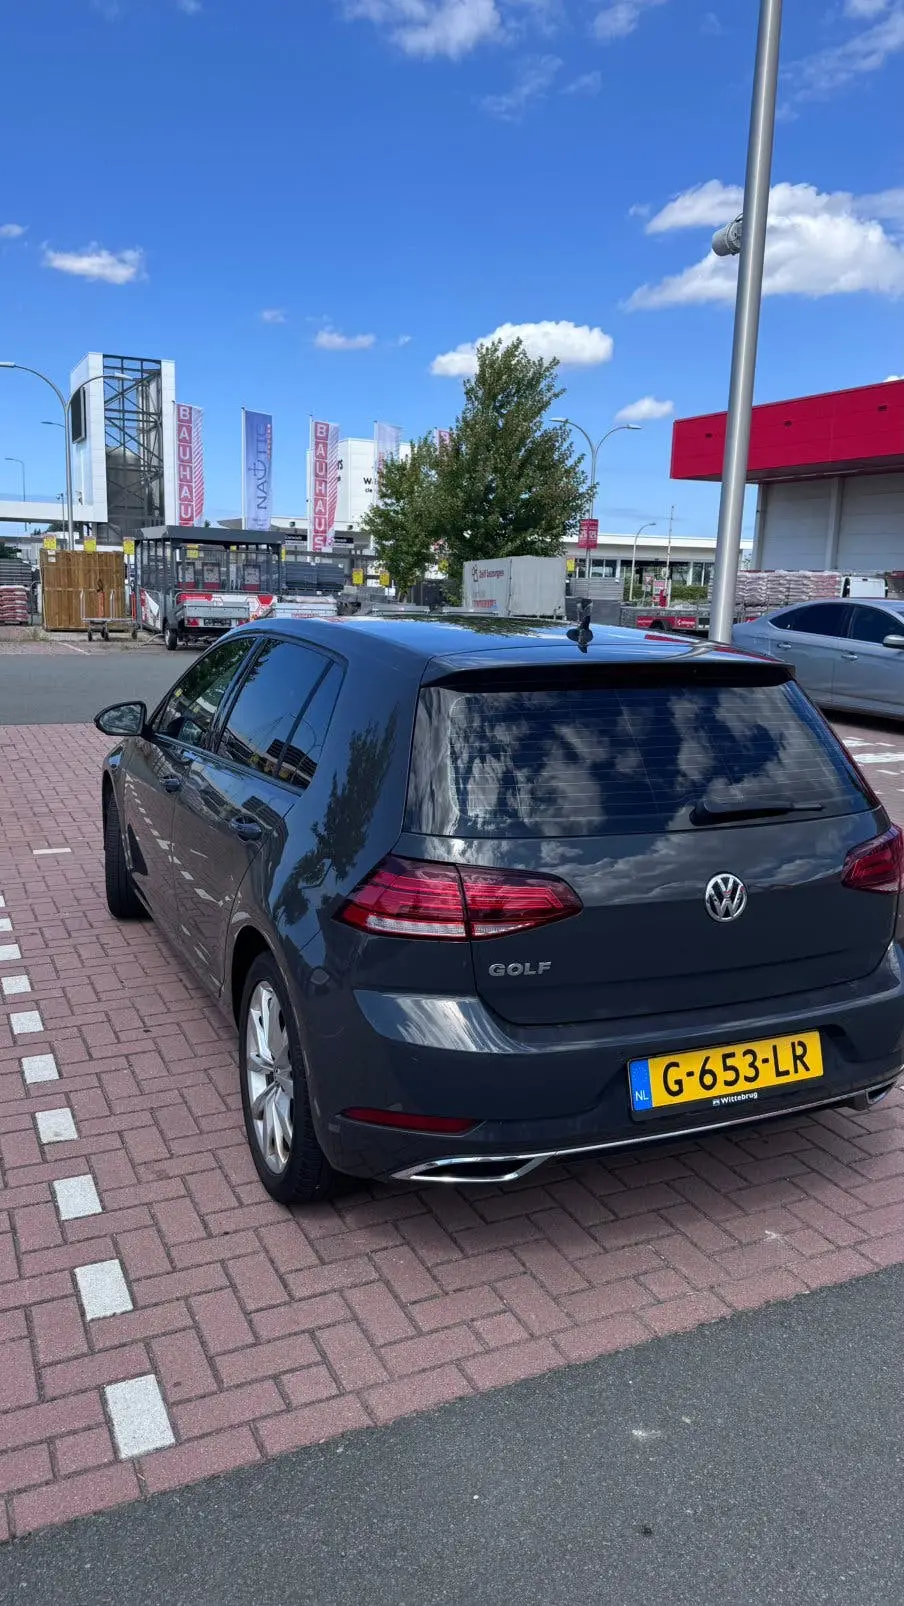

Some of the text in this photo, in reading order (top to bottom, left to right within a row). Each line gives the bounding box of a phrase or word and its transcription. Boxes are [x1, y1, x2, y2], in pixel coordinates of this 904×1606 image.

[179, 405, 193, 525] BAUHAU
[314, 423, 328, 549] BAUHAUS
[488, 961, 552, 977] GOLF
[662, 1040, 811, 1097] G-653-LR
[635, 1090, 649, 1101] NL
[720, 1091, 758, 1105] Wittebrug
